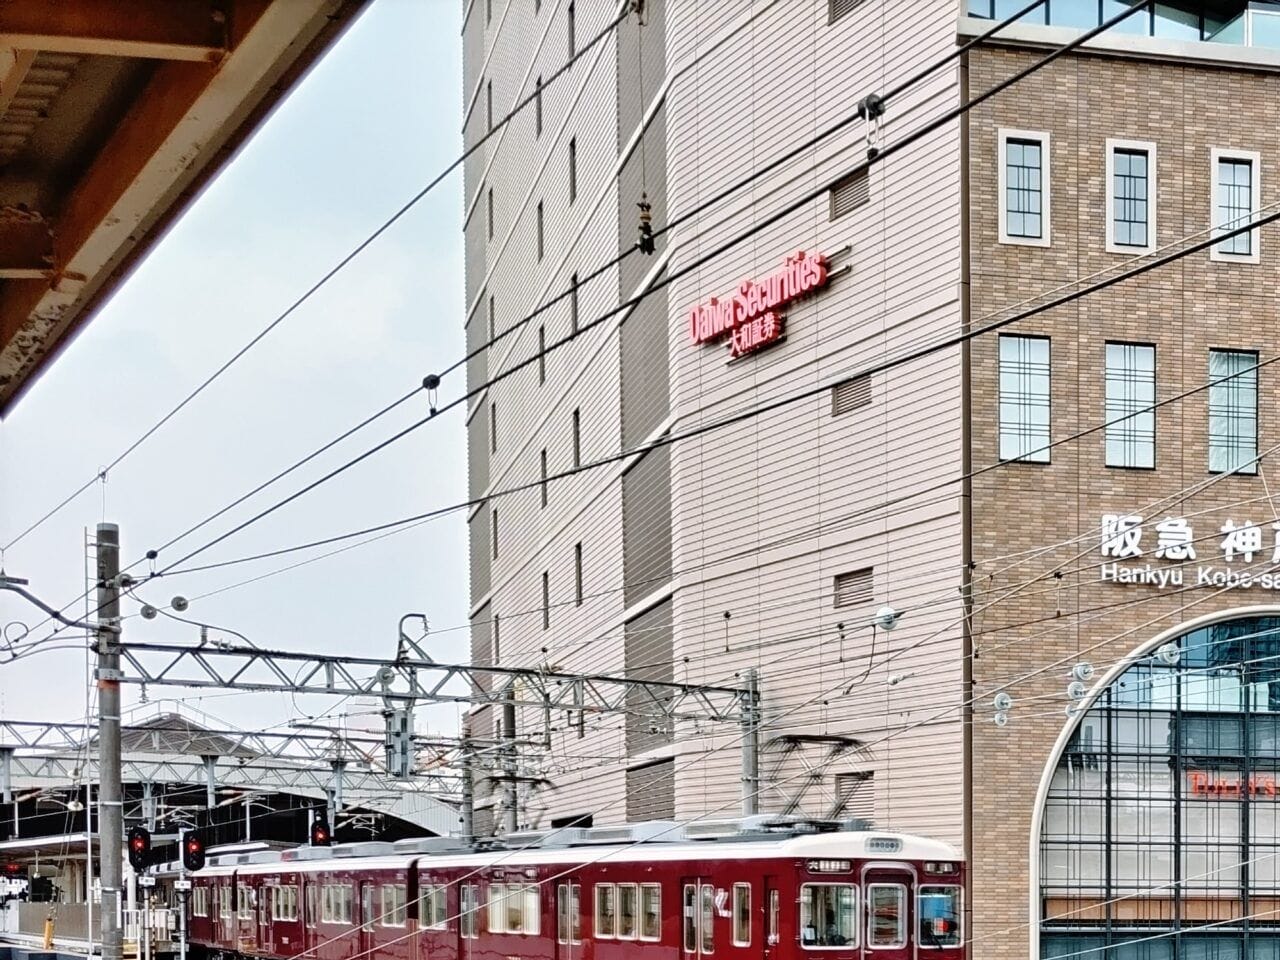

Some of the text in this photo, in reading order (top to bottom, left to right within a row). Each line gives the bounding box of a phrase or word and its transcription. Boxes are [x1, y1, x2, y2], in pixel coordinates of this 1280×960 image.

[688, 250, 828, 344] Daiwa Securities
[730, 312, 780, 357] 大和証券
[1101, 514, 1196, 560] 阪急
[1101, 563, 1184, 587] Hankyu
